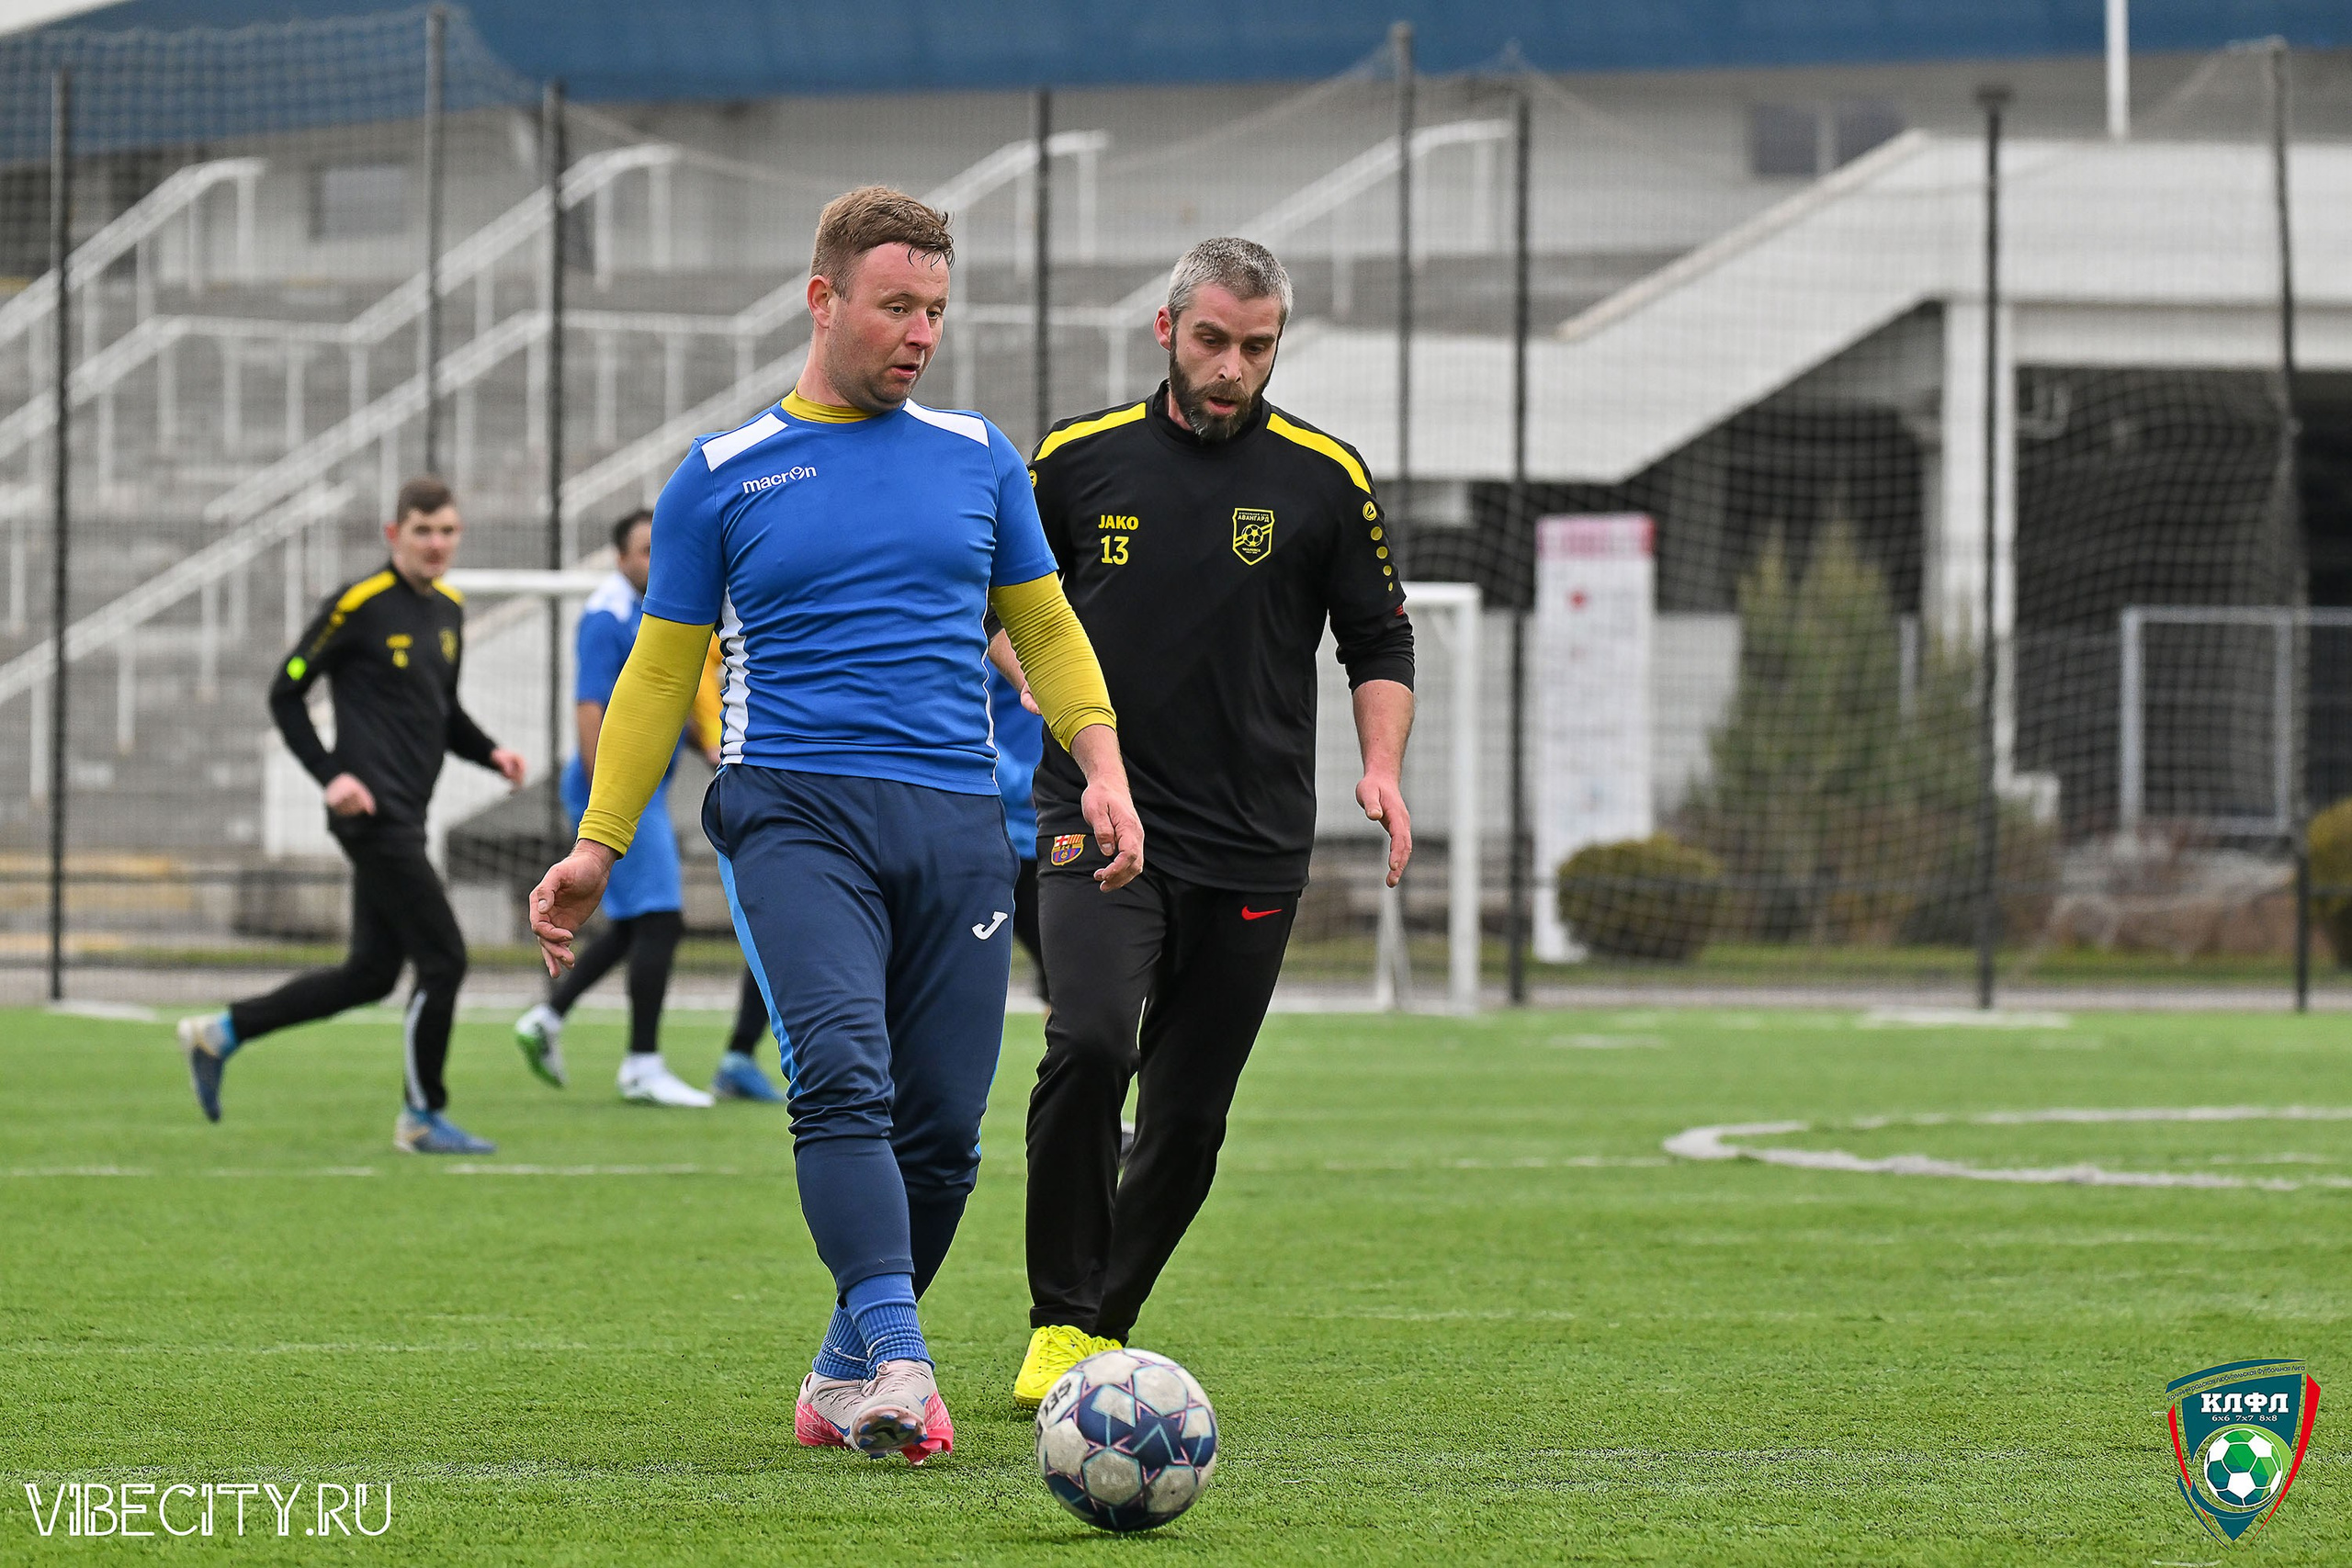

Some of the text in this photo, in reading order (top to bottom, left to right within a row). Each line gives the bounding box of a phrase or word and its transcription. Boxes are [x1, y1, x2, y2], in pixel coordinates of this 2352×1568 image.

[742, 466, 817, 494] macron
[1098, 514, 1139, 530] JAKO
[1101, 535, 1129, 565] 13
